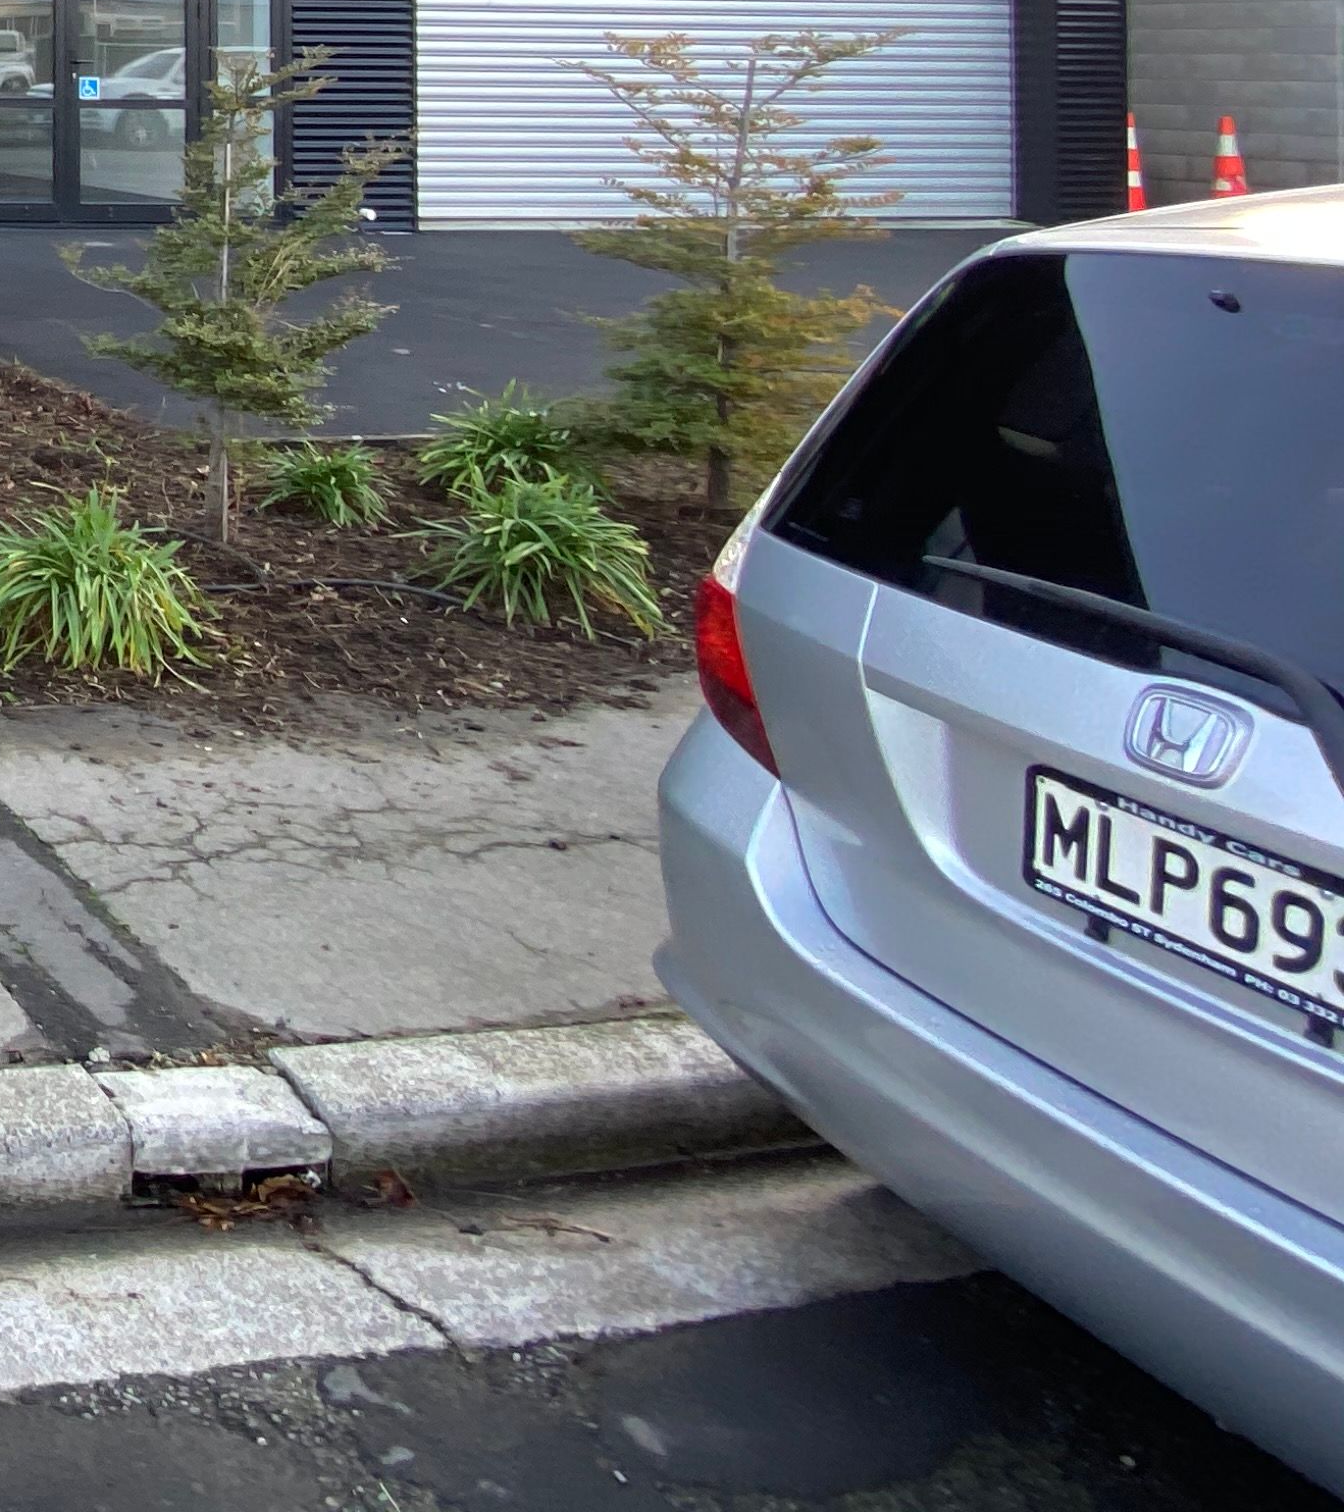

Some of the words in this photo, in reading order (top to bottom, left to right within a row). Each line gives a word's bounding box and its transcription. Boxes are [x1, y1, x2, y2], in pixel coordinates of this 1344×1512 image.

[1117, 796, 1216, 844] Handy
[1225, 840, 1301, 878] Cars
[1042, 791, 1344, 996] MLP69
[1065, 893, 1129, 928] Colombo
[1153, 933, 1237, 977] Sydenham
